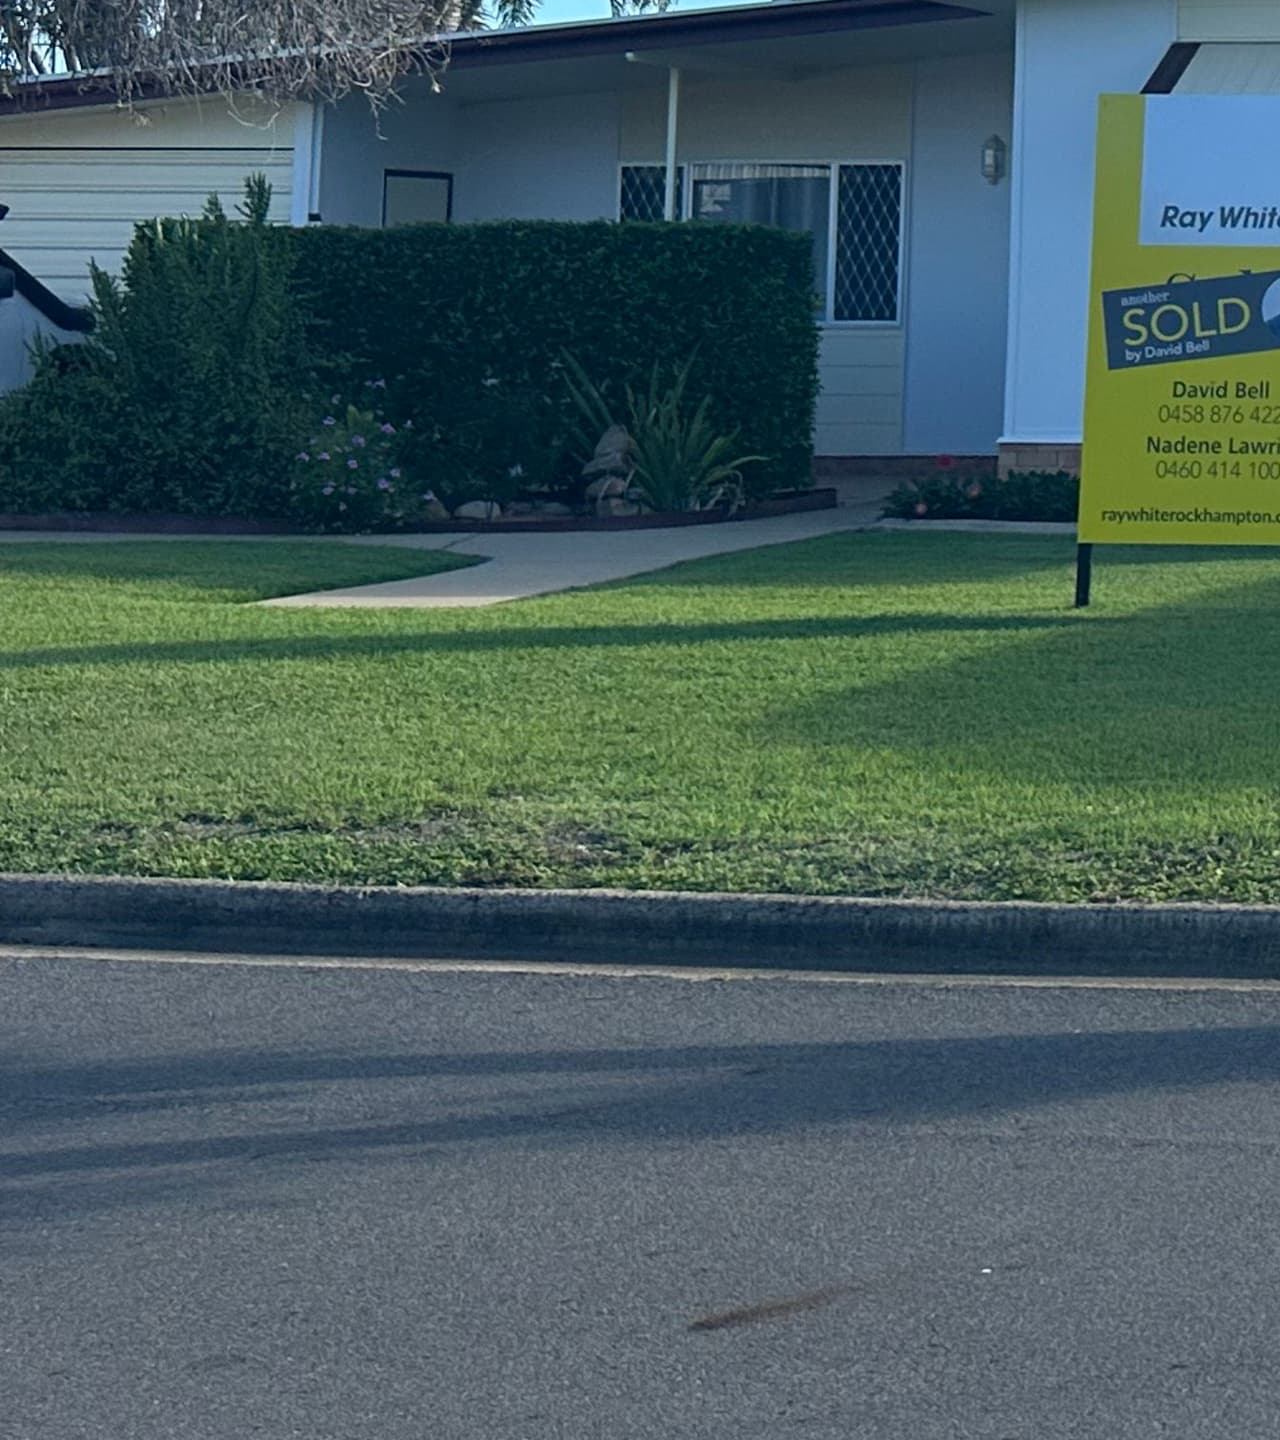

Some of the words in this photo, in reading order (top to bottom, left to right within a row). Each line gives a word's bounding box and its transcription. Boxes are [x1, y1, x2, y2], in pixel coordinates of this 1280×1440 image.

[1160, 205, 1214, 232] Ray
[1120, 291, 1171, 306] another
[1122, 297, 1251, 347] SOLD
[1124, 347, 1142, 363] by
[1145, 340, 1183, 359] David
[1186, 339, 1210, 353] Bell
[1172, 381, 1227, 399] David
[1235, 381, 1270, 399] Bell
[1158, 405, 1204, 424] 0458
[1210, 405, 1244, 424] 876
[1146, 436, 1222, 454] Nadene
[1155, 460, 1201, 479] 0460
[1207, 461, 1241, 479] 414
